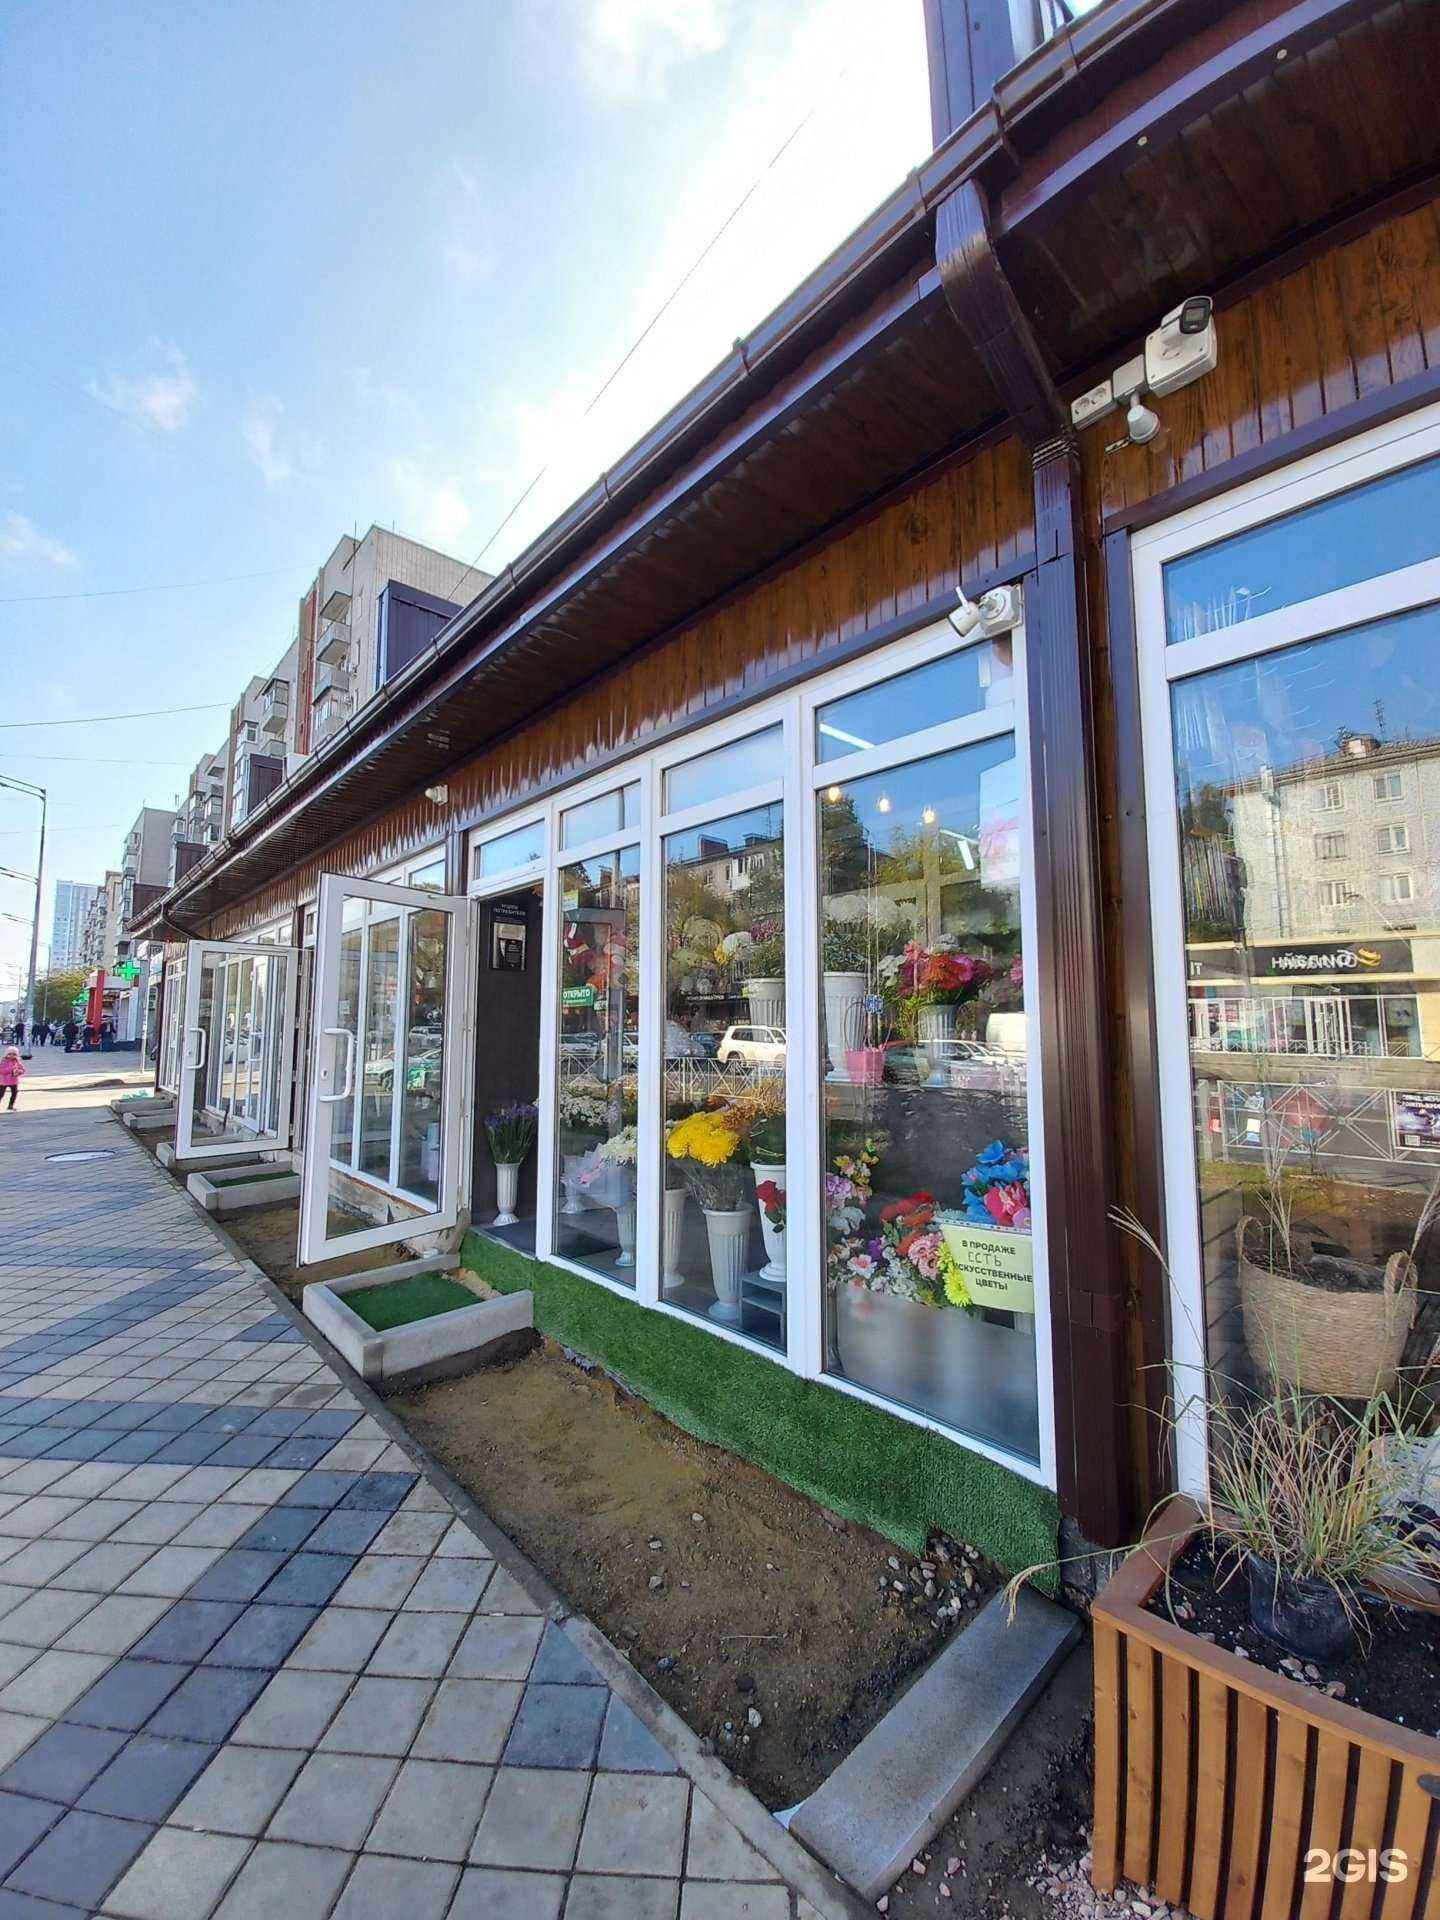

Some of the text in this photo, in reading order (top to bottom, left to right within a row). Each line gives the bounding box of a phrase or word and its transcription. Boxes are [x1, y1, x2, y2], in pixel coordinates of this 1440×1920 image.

[969, 1240, 1016, 1255] ПРОДАЖЕ
[968, 1251, 1002, 1267] ЕСТЬ
[975, 1278, 1008, 1291] ЦВЕТЫ
